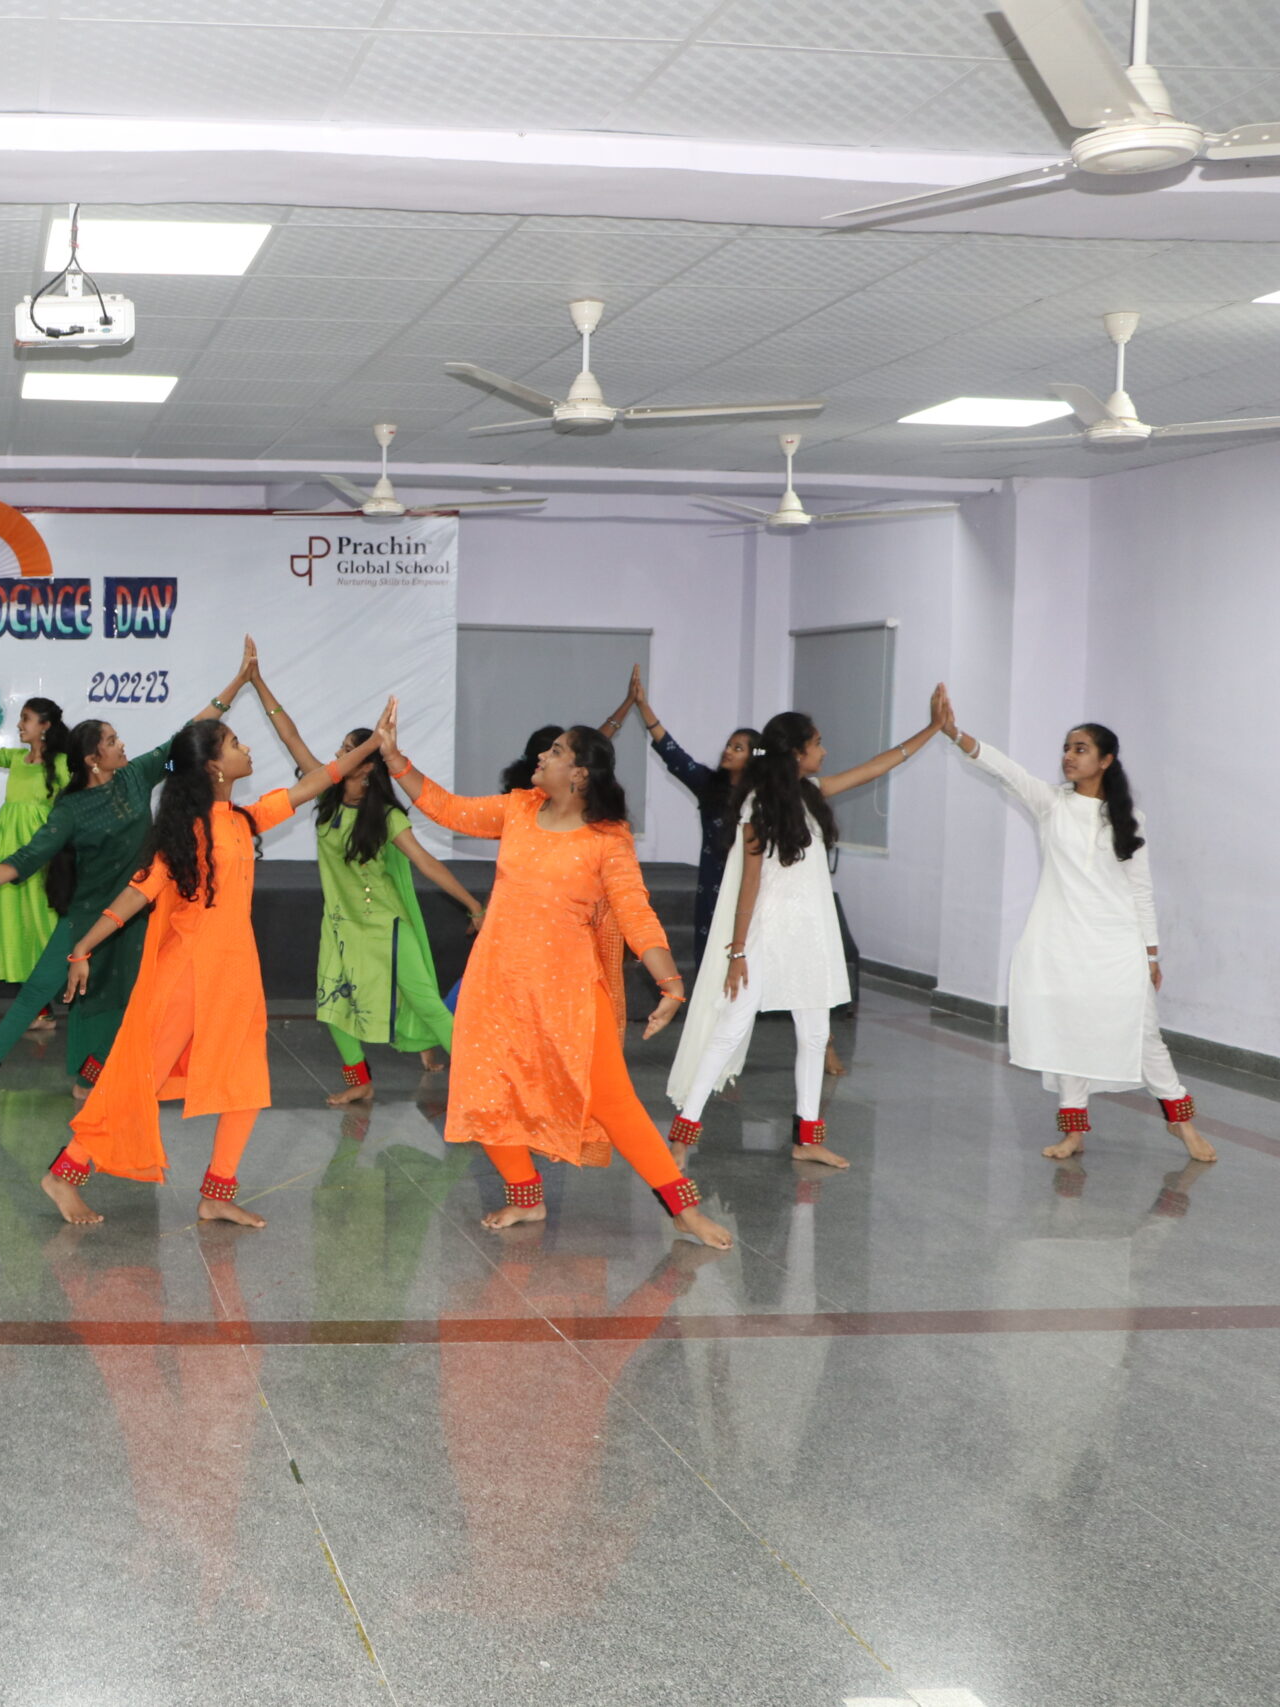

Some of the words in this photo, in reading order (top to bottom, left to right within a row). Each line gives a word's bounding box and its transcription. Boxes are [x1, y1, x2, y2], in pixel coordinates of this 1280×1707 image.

[337, 536, 427, 555] Prachin
[336, 561, 390, 575] Global
[395, 561, 450, 575] School
[116, 584, 174, 633] DAY
[87, 669, 170, 704] 2022-23
